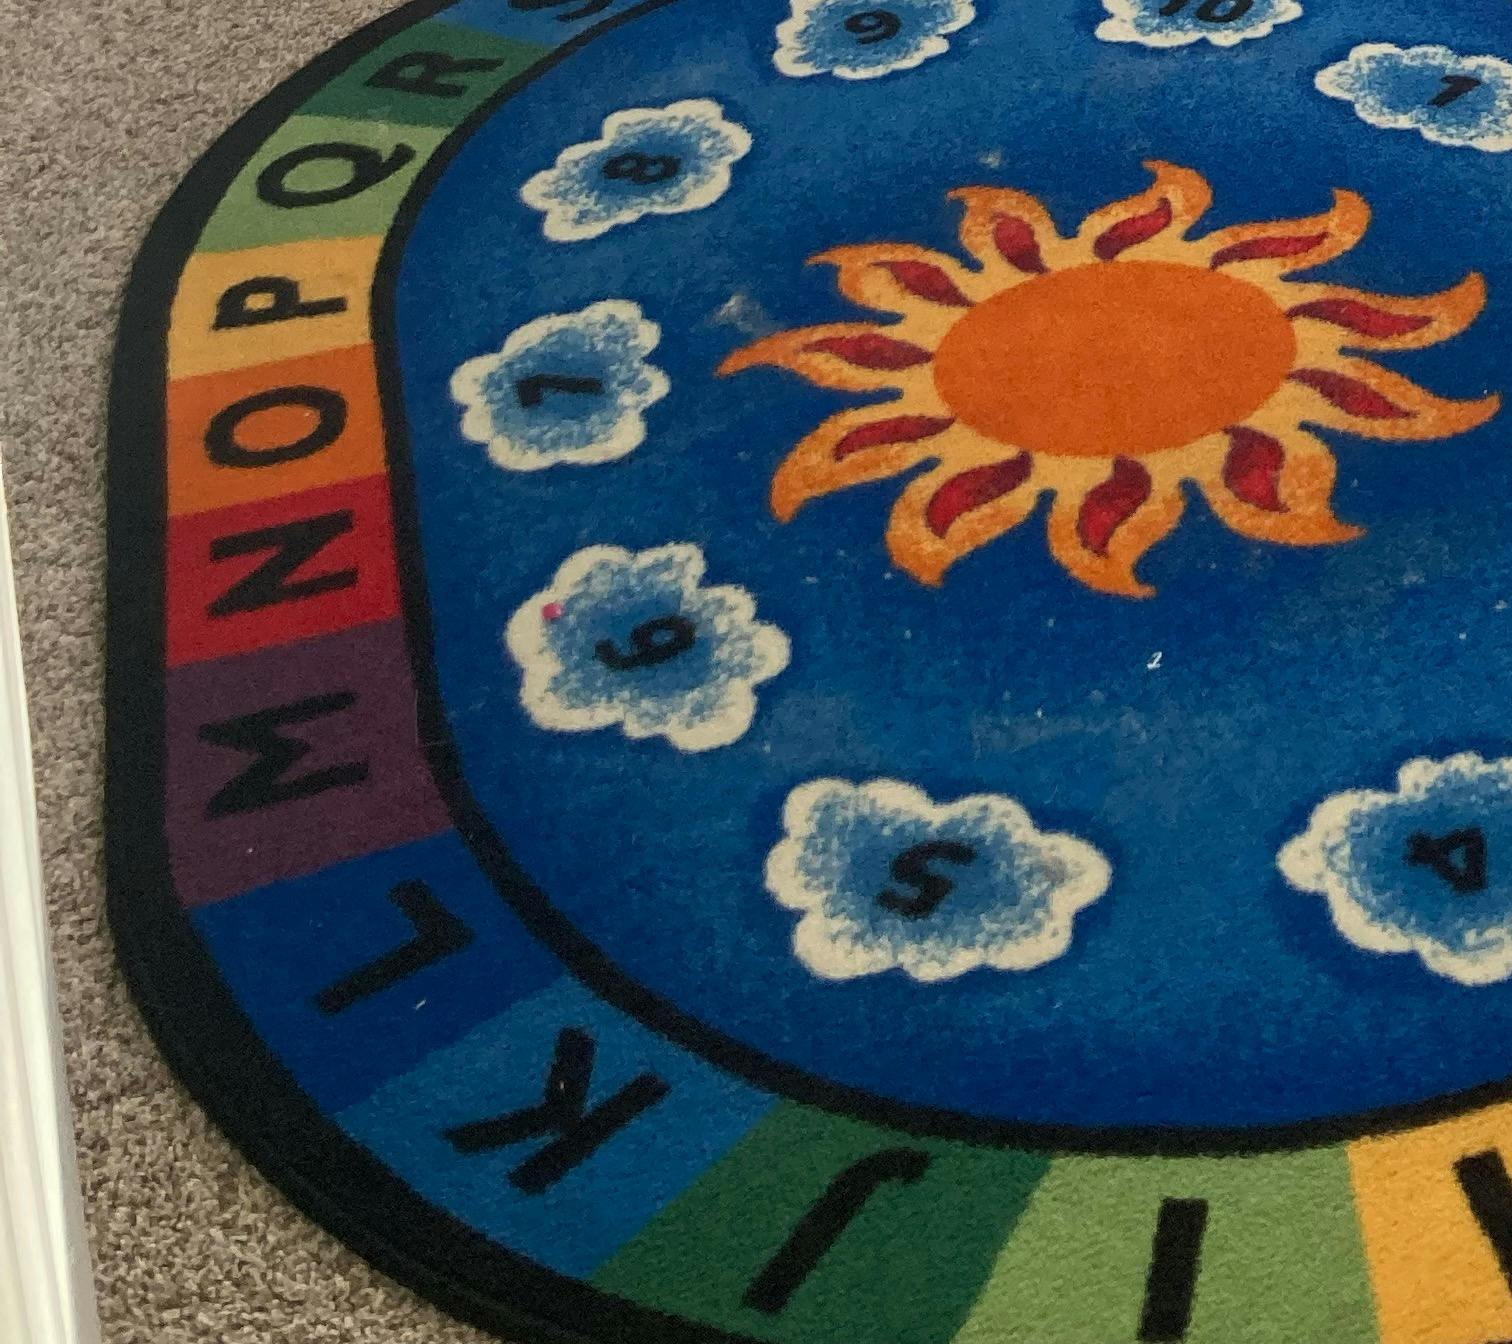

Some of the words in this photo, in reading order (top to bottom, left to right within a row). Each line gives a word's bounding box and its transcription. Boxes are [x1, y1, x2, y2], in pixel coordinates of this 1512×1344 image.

[844, 8, 903, 44] 9
[364, 50, 503, 97] R
[1426, 74, 1481, 106] 1
[255, 141, 417, 208] Q
[603, 153, 681, 186] 8
[210, 275, 348, 332] P
[515, 374, 602, 408] 7
[205, 385, 348, 469] O
[207, 510, 359, 618] N
[595, 615, 697, 671] 6
[200, 691, 371, 822] M
[877, 840, 976, 918] 5
[1406, 826, 1488, 896] 4
[313, 879, 476, 1015] L
[440, 1025, 672, 1193] K
[742, 1146, 933, 1310] J
[1137, 1197, 1208, 1344] I
